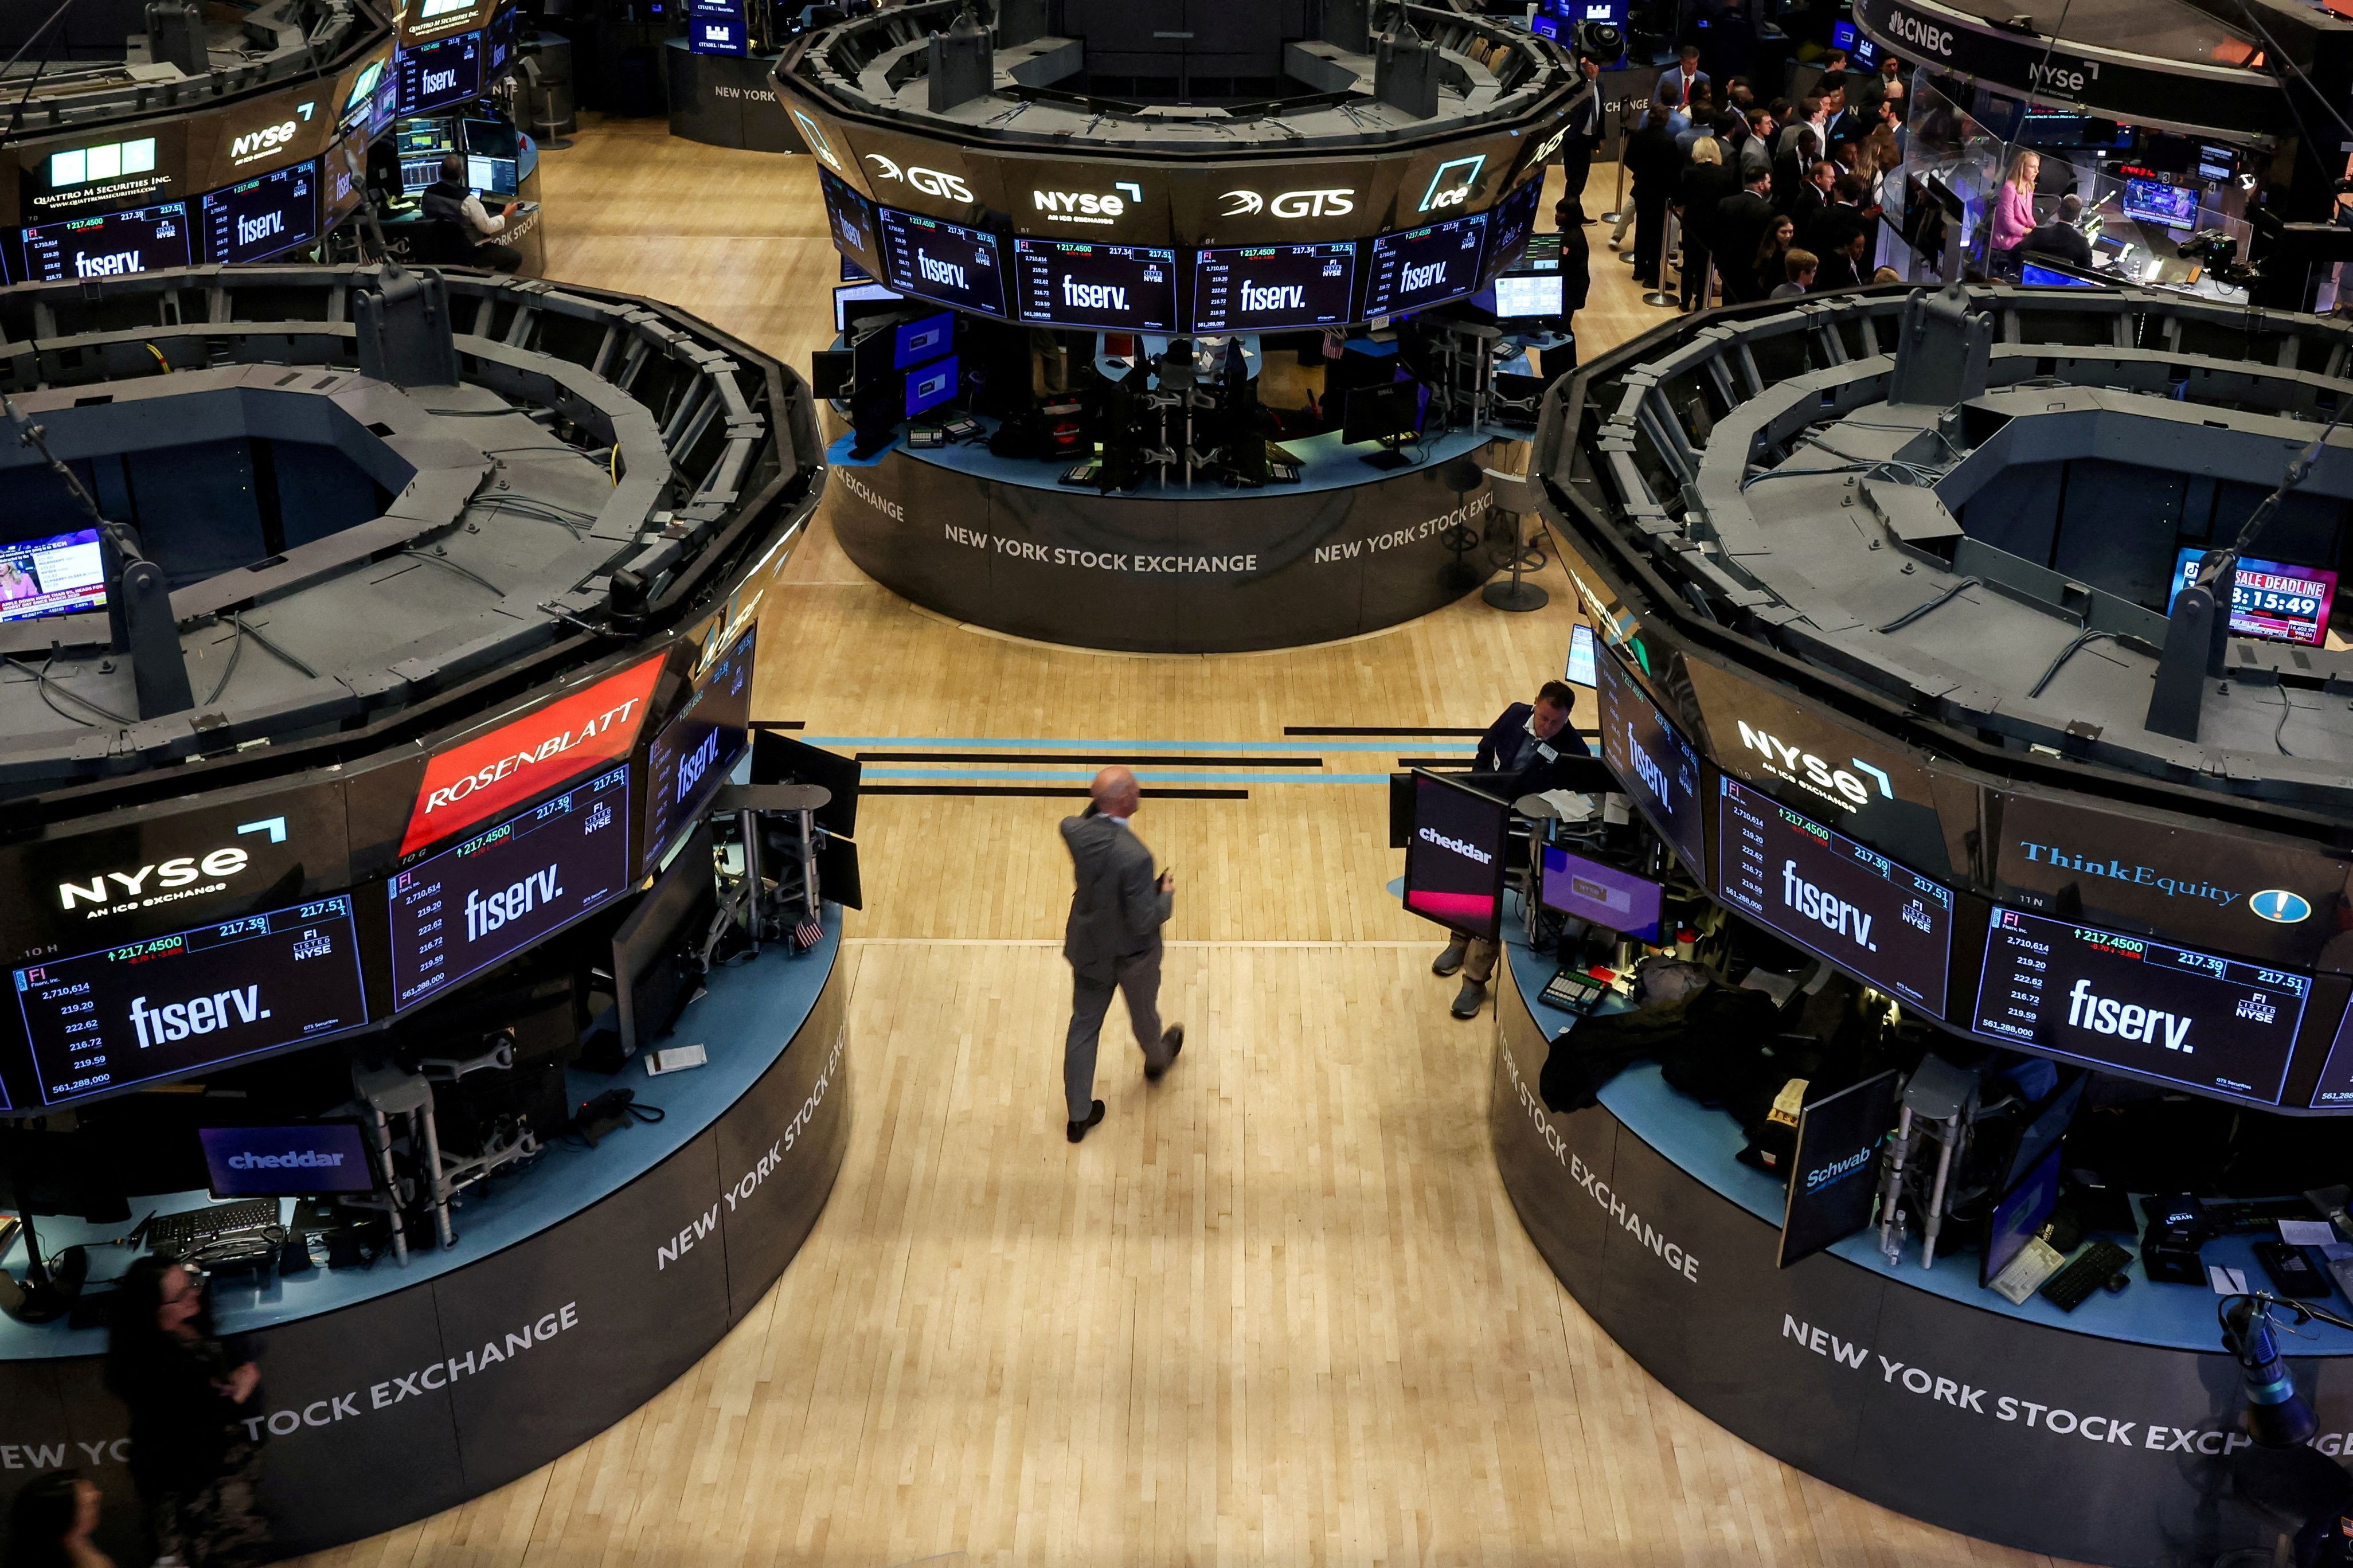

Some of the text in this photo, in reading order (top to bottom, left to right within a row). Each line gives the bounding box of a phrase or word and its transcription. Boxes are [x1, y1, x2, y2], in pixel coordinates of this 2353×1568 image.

[409, 22, 433, 33] QUATTRO
[1905, 18, 1953, 56] CNBC
[423, 69, 456, 95] fiserv.
[716, 86, 776, 102] NEW YORK
[907, 167, 974, 203] GTS
[2163, 174, 2170, 182] 3
[34, 191, 81, 205] QUATTRO
[96, 179, 148, 194] SECURITIES
[152, 175, 171, 185] INC.
[2209, 185, 2215, 193] 4
[1271, 189, 1355, 218] GTS
[238, 210, 284, 245] fiserv.
[1061, 244, 1092, 252] 217.4500
[1245, 249, 1275, 257] 217.4500
[75, 250, 145, 278] fiserv.
[918, 248, 970, 290] fiserv.
[1400, 261, 1447, 293] fiserv.
[1062, 275, 1129, 310] fiserv.
[1241, 280, 1305, 311] fiserv.
[846, 475, 904, 522] EXCHANGE
[1315, 505, 1467, 564] NEW YORK STOCK
[945, 523, 1257, 573] NEW YORK STOCK EXCHANGE
[2265, 574, 2324, 597] DEADLINE
[424, 697, 639, 814] ROSENBLATT
[677, 726, 718, 804] fiserv.
[1628, 721, 1672, 814] fiserv.
[1762, 761, 1777, 774] AN
[593, 769, 624, 792] 217.51
[1729, 782, 1739, 796] FI
[537, 796, 569, 820] 217.39
[585, 808, 611, 826] LISTED
[593, 801, 603, 814] FI
[1734, 807, 1764, 827] 2,710,614
[585, 815, 611, 835] NYSE
[1785, 812, 1828, 840] 217.4500
[464, 824, 510, 855] 217.4500
[1420, 826, 1492, 865] cheddar
[1742, 828, 1763, 844] 219.20
[1742, 845, 1763, 861] 222.62
[1855, 847, 1888, 871] 217.39
[1742, 862, 1763, 878] 216.72
[2020, 840, 2242, 907] ThinkEquity
[399, 873, 411, 888] FI
[1742, 878, 1762, 894] 219.59
[1913, 877, 1948, 901] 217.51
[406, 882, 441, 905] 2,710,614
[464, 863, 563, 943] fiserv.
[87, 908, 111, 919] AN
[300, 899, 345, 918] 217.51
[417, 901, 441, 918] 219.20
[1783, 859, 1877, 952] fiserv.
[1903, 905, 1931, 924] LISTED
[1913, 899, 1923, 912] FI
[220, 917, 265, 937] 217.39
[419, 918, 442, 936] 222.62
[1902, 912, 1930, 934] NYSE
[2004, 912, 2019, 926] FI
[293, 937, 330, 951] LISTED
[304, 929, 317, 940] FI
[2007, 936, 2050, 952] 2,710,614
[2083, 930, 2143, 952] 217.4500
[25, 948, 42, 957] 10
[118, 936, 182, 960] 217.4500
[295, 945, 331, 961] NYSE
[419, 936, 443, 954] 216.72
[420, 954, 444, 972] 219.59
[2016, 956, 2046, 969] 219.20
[2178, 953, 2223, 970] 217.39
[29, 968, 46, 982] FI
[2014, 973, 2043, 987] 222.62
[2257, 971, 2303, 990] 217.51
[42, 982, 89, 1000] 2,710,614
[402, 972, 444, 1000] 561,288,000
[2011, 991, 2039, 1003] 216.72
[2253, 992, 2266, 1004] FI
[61, 1001, 93, 1015] 219.20
[130, 985, 271, 1049] fiserv.
[2007, 1007, 2037, 1020] 219.59
[2069, 979, 2195, 1054] fiserv.
[2235, 1007, 2274, 1023] NYSE
[2238, 1001, 2276, 1014] LISTED
[65, 1019, 98, 1033] 222.62
[1983, 1019, 2033, 1037] 561,288,000
[69, 1038, 102, 1051] 216.72
[73, 1055, 105, 1069] 219.59
[53, 1073, 110, 1094] 561,288,000
[229, 1151, 343, 1170] cheddar
[658, 1066, 829, 1271] NEW YORK STOCK
[1807, 1147, 1870, 1187] Schwab
[1520, 1081, 1568, 1167] STOCK
[1571, 1153, 1699, 1284] EXCHANGE
[1, 1301, 579, 1469] EW YO TOCK EXCHANGE
[1782, 1312, 2353, 1457] NEW YORK STOCK EXCHGE
